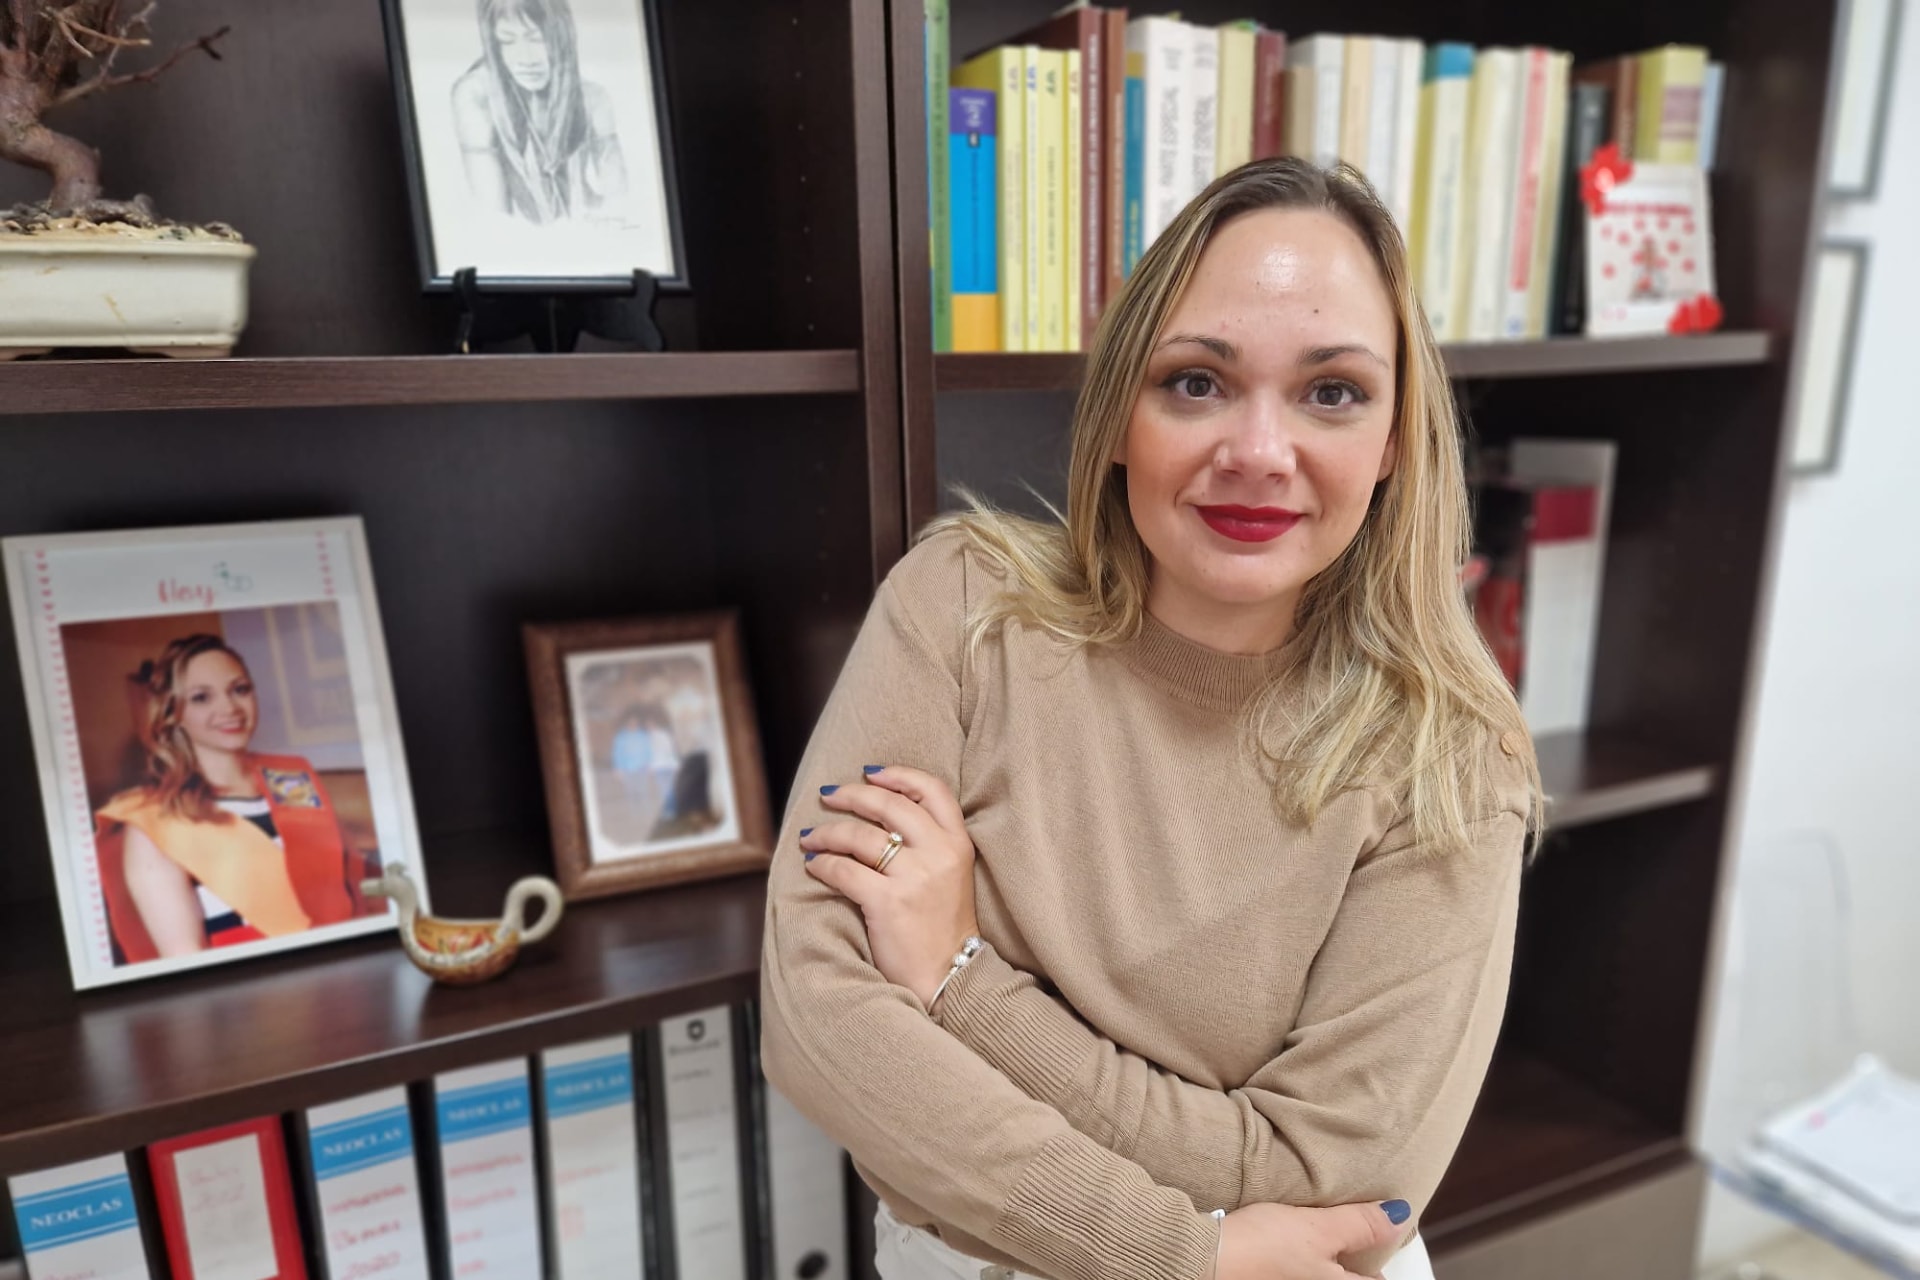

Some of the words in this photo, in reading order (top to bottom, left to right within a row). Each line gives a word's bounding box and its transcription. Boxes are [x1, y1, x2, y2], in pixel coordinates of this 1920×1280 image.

[555, 1074, 626, 1098] NEOCLAS
[446, 1098, 523, 1123] NEOCLAS
[322, 1128, 404, 1157] NEOCLAS
[30, 1196, 124, 1230] NEOCLAS
